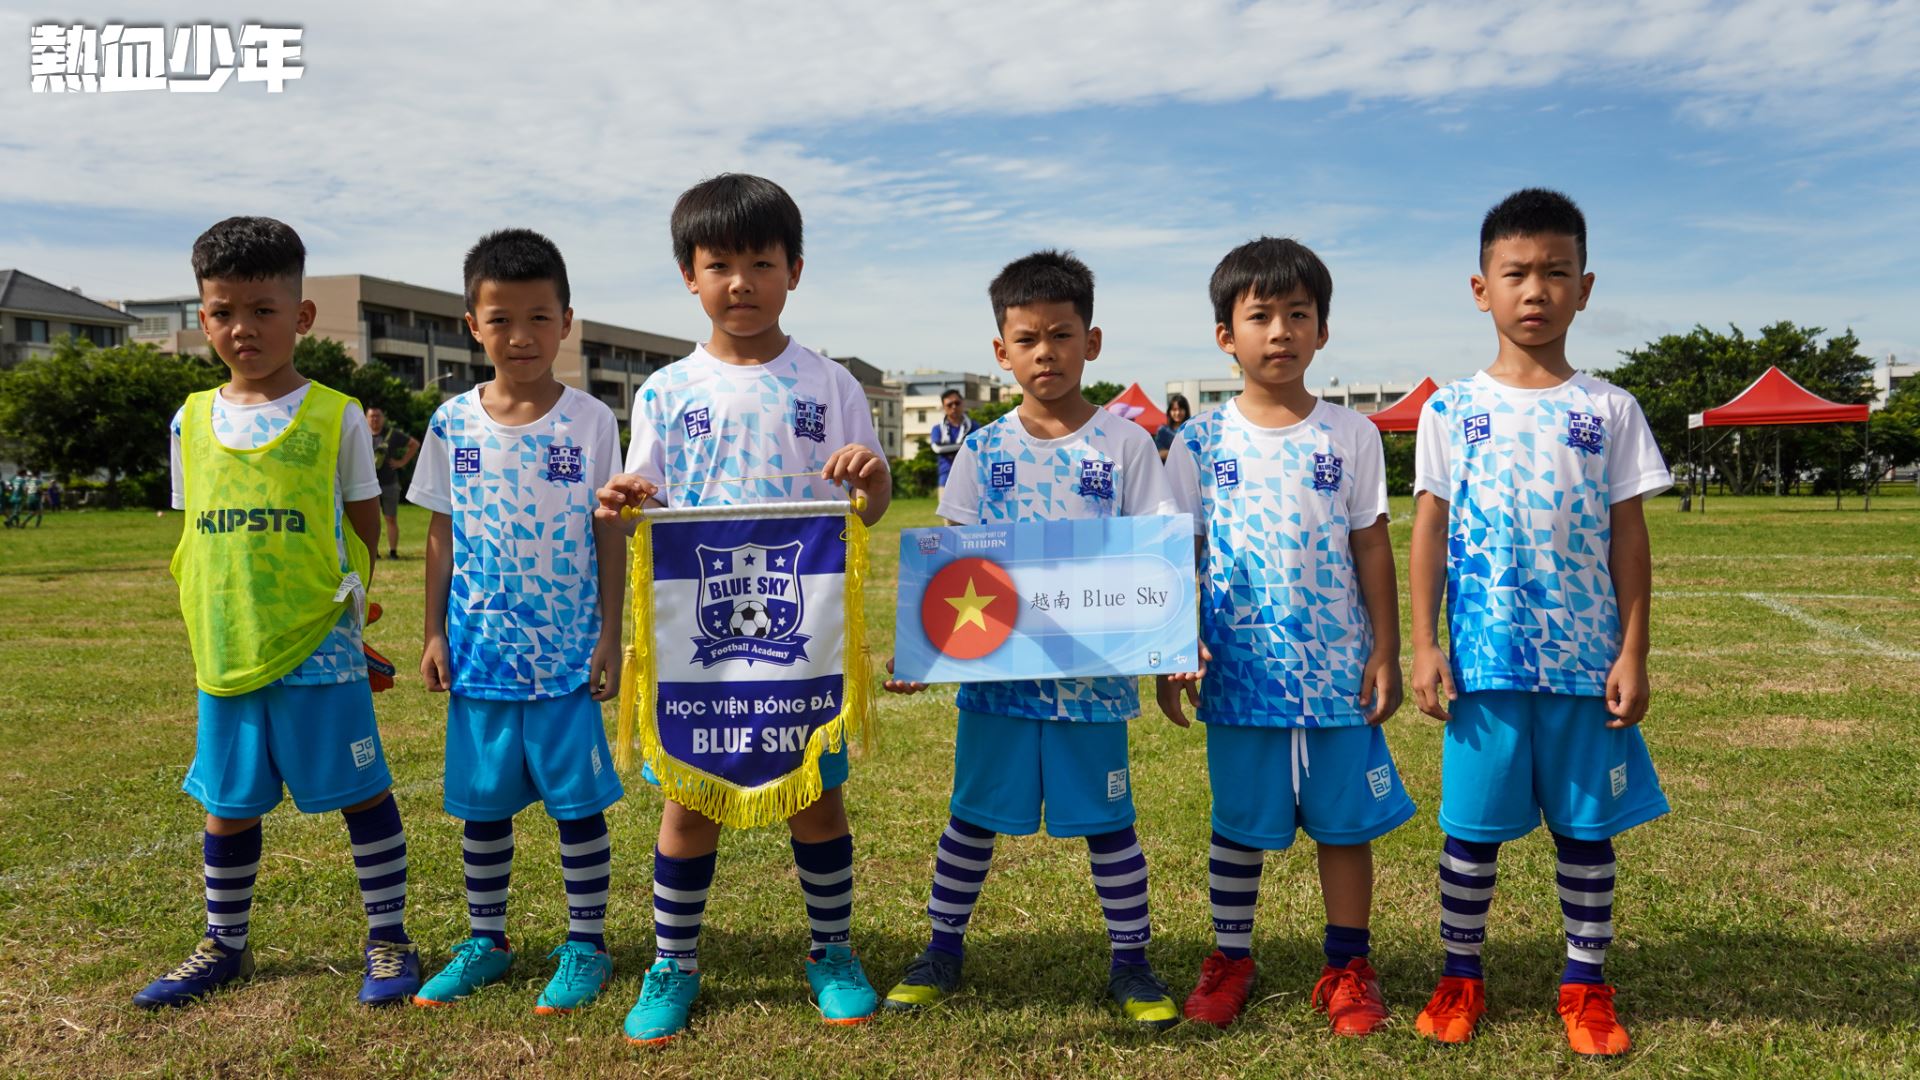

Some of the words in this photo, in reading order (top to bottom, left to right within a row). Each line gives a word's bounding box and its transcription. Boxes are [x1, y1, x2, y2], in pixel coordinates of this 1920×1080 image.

[962, 539, 1007, 549] TAIWAN
[708, 577, 752, 600] BLUE
[757, 576, 790, 597] SKY
[1030, 590, 1070, 611] 越南
[1083, 589, 1126, 607] Blue
[1136, 587, 1168, 607] Sky
[710, 643, 749, 658] Football
[751, 644, 790, 660] Academy
[665, 700, 707, 719] HỌC
[711, 696, 749, 719] VIỆN
[754, 695, 806, 714] BÓNG
[811, 690, 836, 711] ĐÁ
[692, 727, 753, 754] BLUE
[761, 724, 810, 753] SKY
